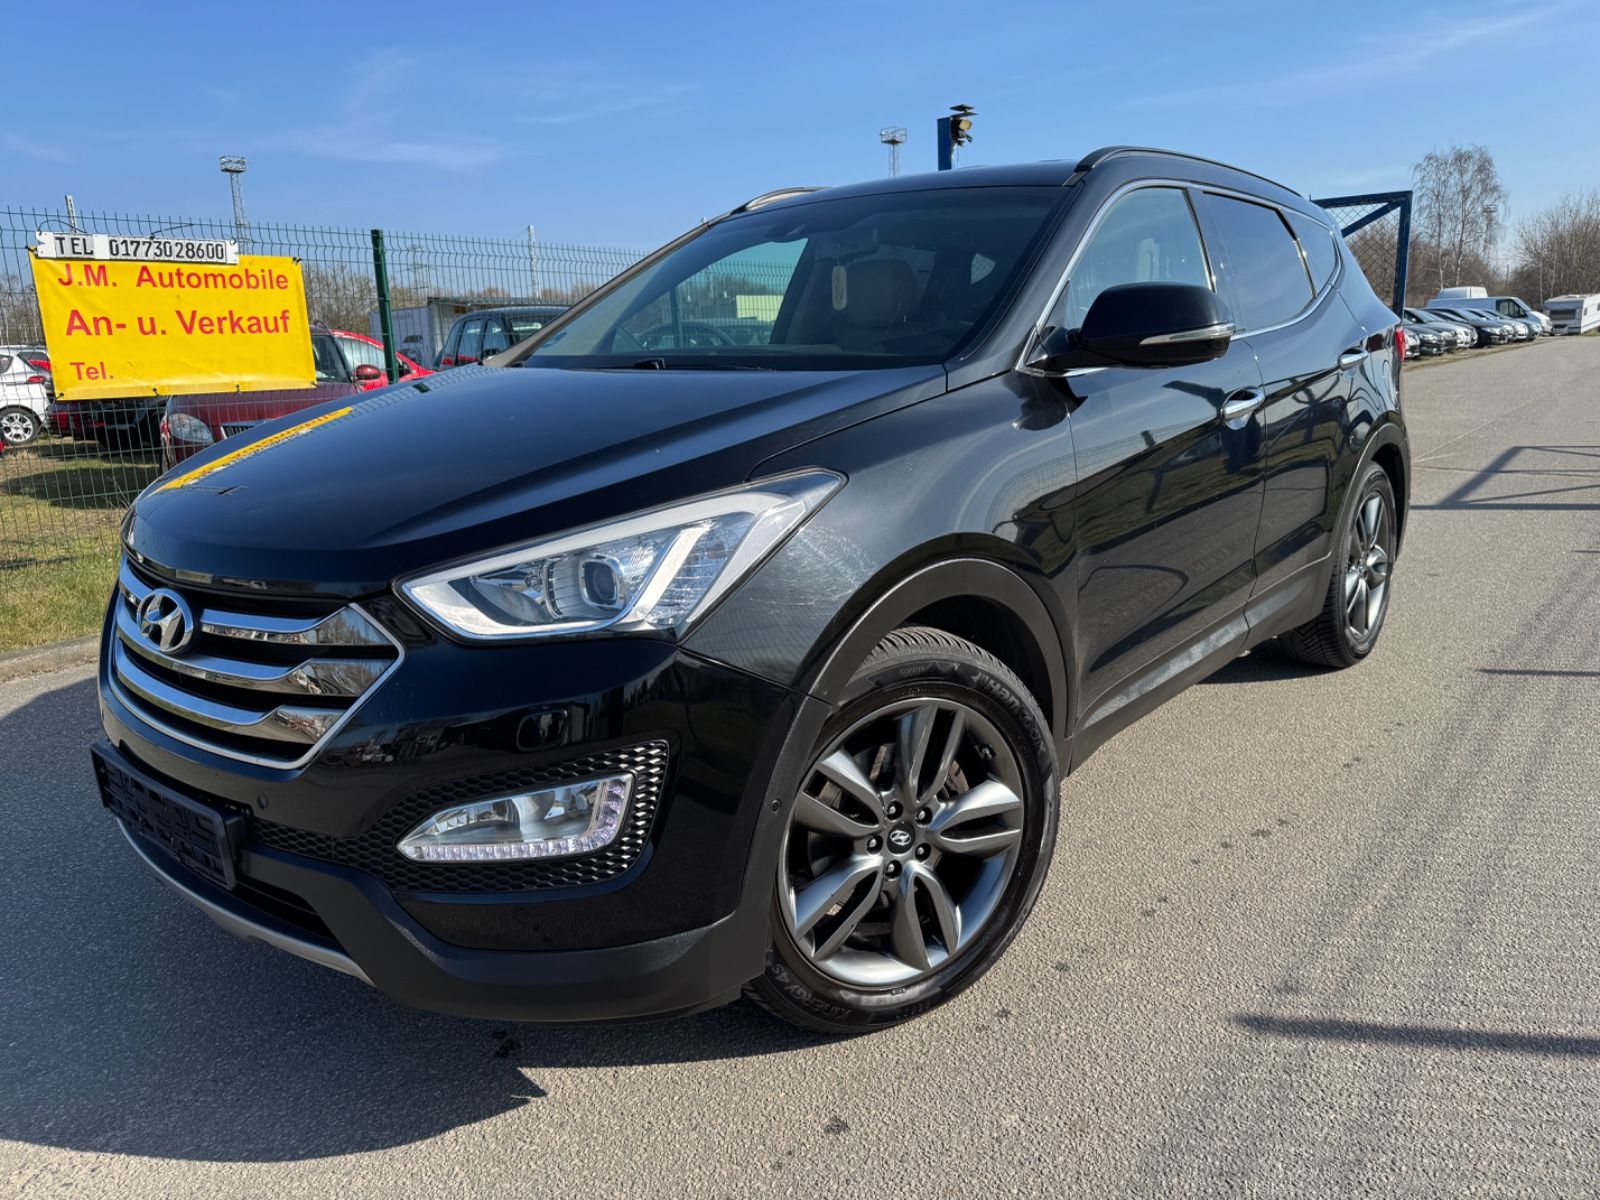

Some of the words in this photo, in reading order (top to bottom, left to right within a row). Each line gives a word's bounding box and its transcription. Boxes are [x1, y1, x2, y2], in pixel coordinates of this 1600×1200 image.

[55, 236, 94, 256] TEL
[109, 238, 224, 260] 01773028600
[58, 264, 117, 287] J.M.
[136, 265, 289, 290] Automobile
[65, 309, 127, 336] An-
[138, 318, 166, 336] u.
[175, 310, 290, 334] Verkauf
[70, 361, 114, 381] Tel.
